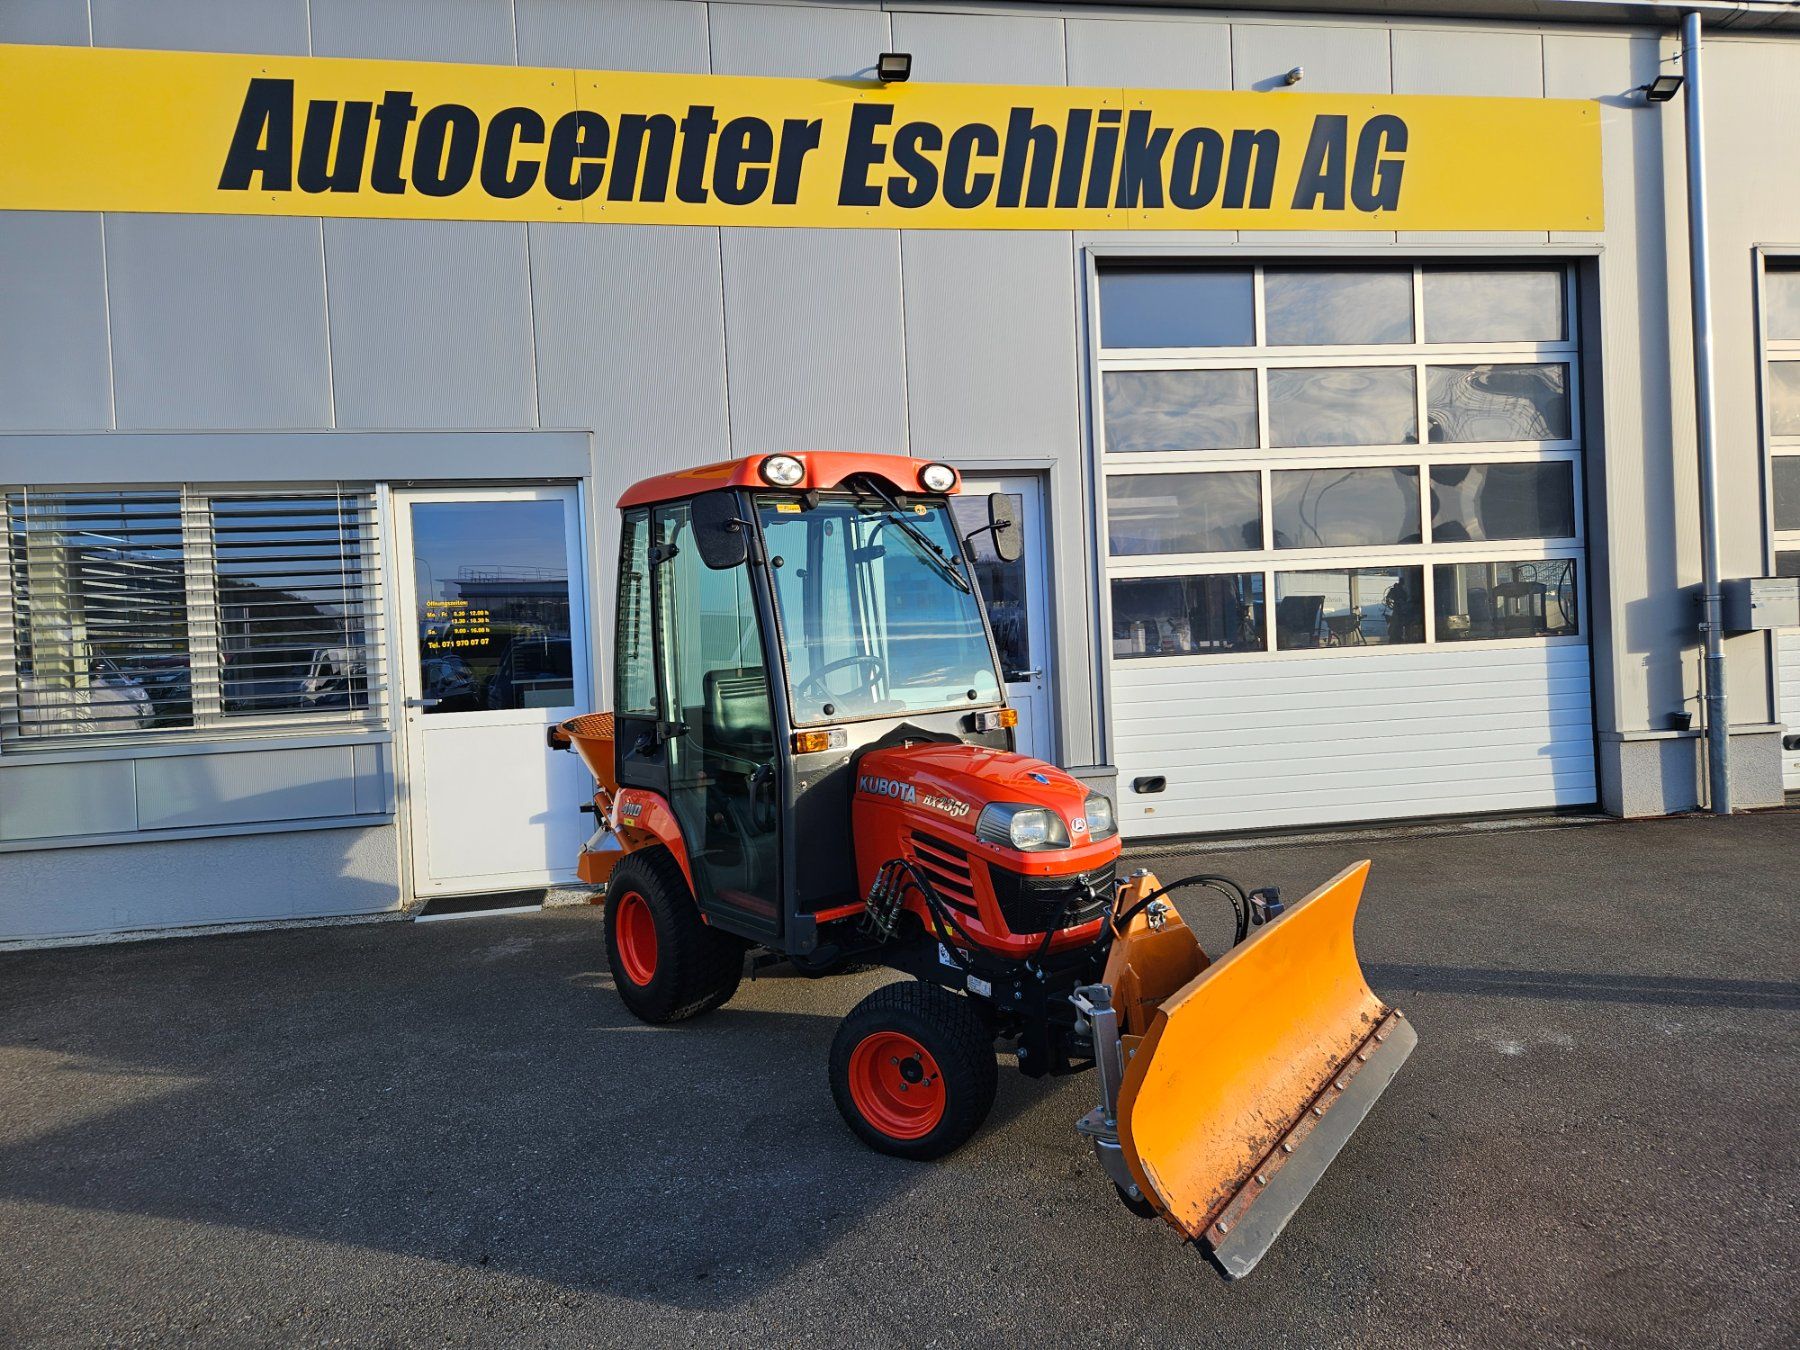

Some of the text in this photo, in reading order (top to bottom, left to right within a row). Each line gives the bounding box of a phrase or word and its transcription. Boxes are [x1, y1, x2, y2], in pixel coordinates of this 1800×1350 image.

[217, 77, 1408, 211] Autocenter Eschlikon AG
[858, 775, 917, 804] KUBOTA
[922, 794, 970, 817] BX2350
